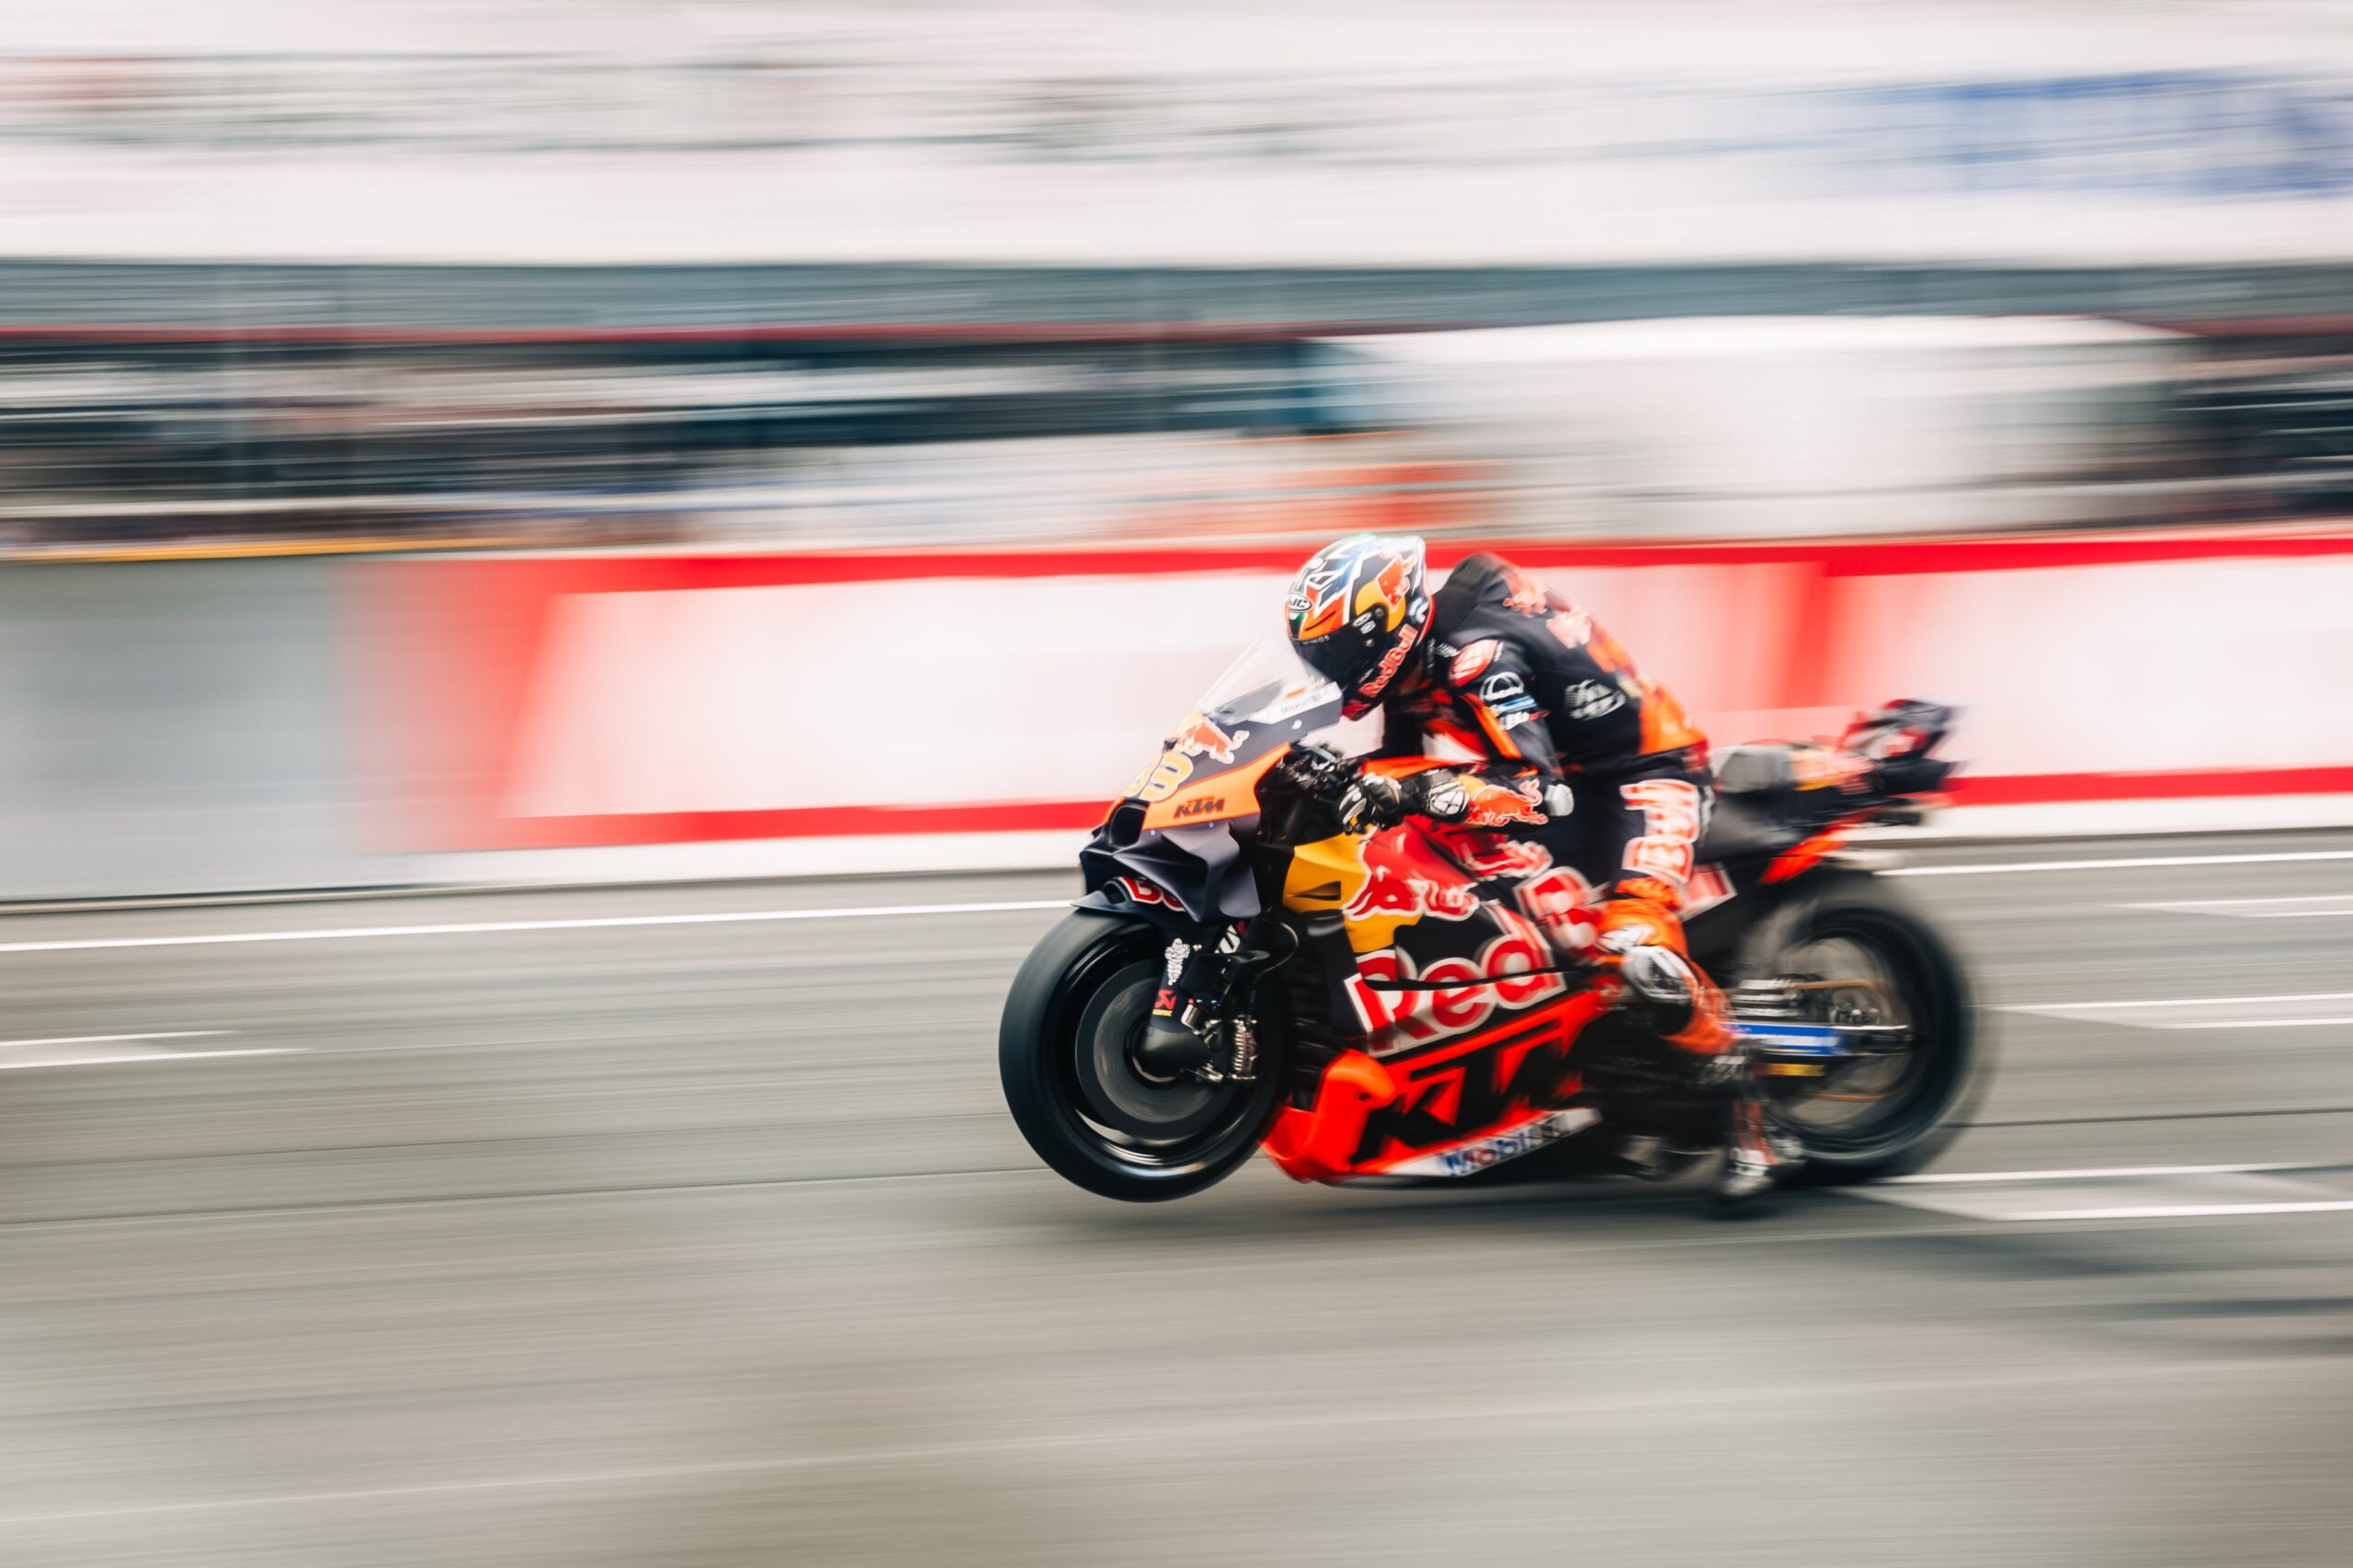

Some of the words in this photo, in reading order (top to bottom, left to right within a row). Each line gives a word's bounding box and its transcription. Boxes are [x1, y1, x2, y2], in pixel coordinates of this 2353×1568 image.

[1358, 660, 1398, 698] Red
[1384, 623, 1419, 666] Bull
[1174, 795, 1226, 820] KTM
[1343, 898, 1568, 1058] Red
